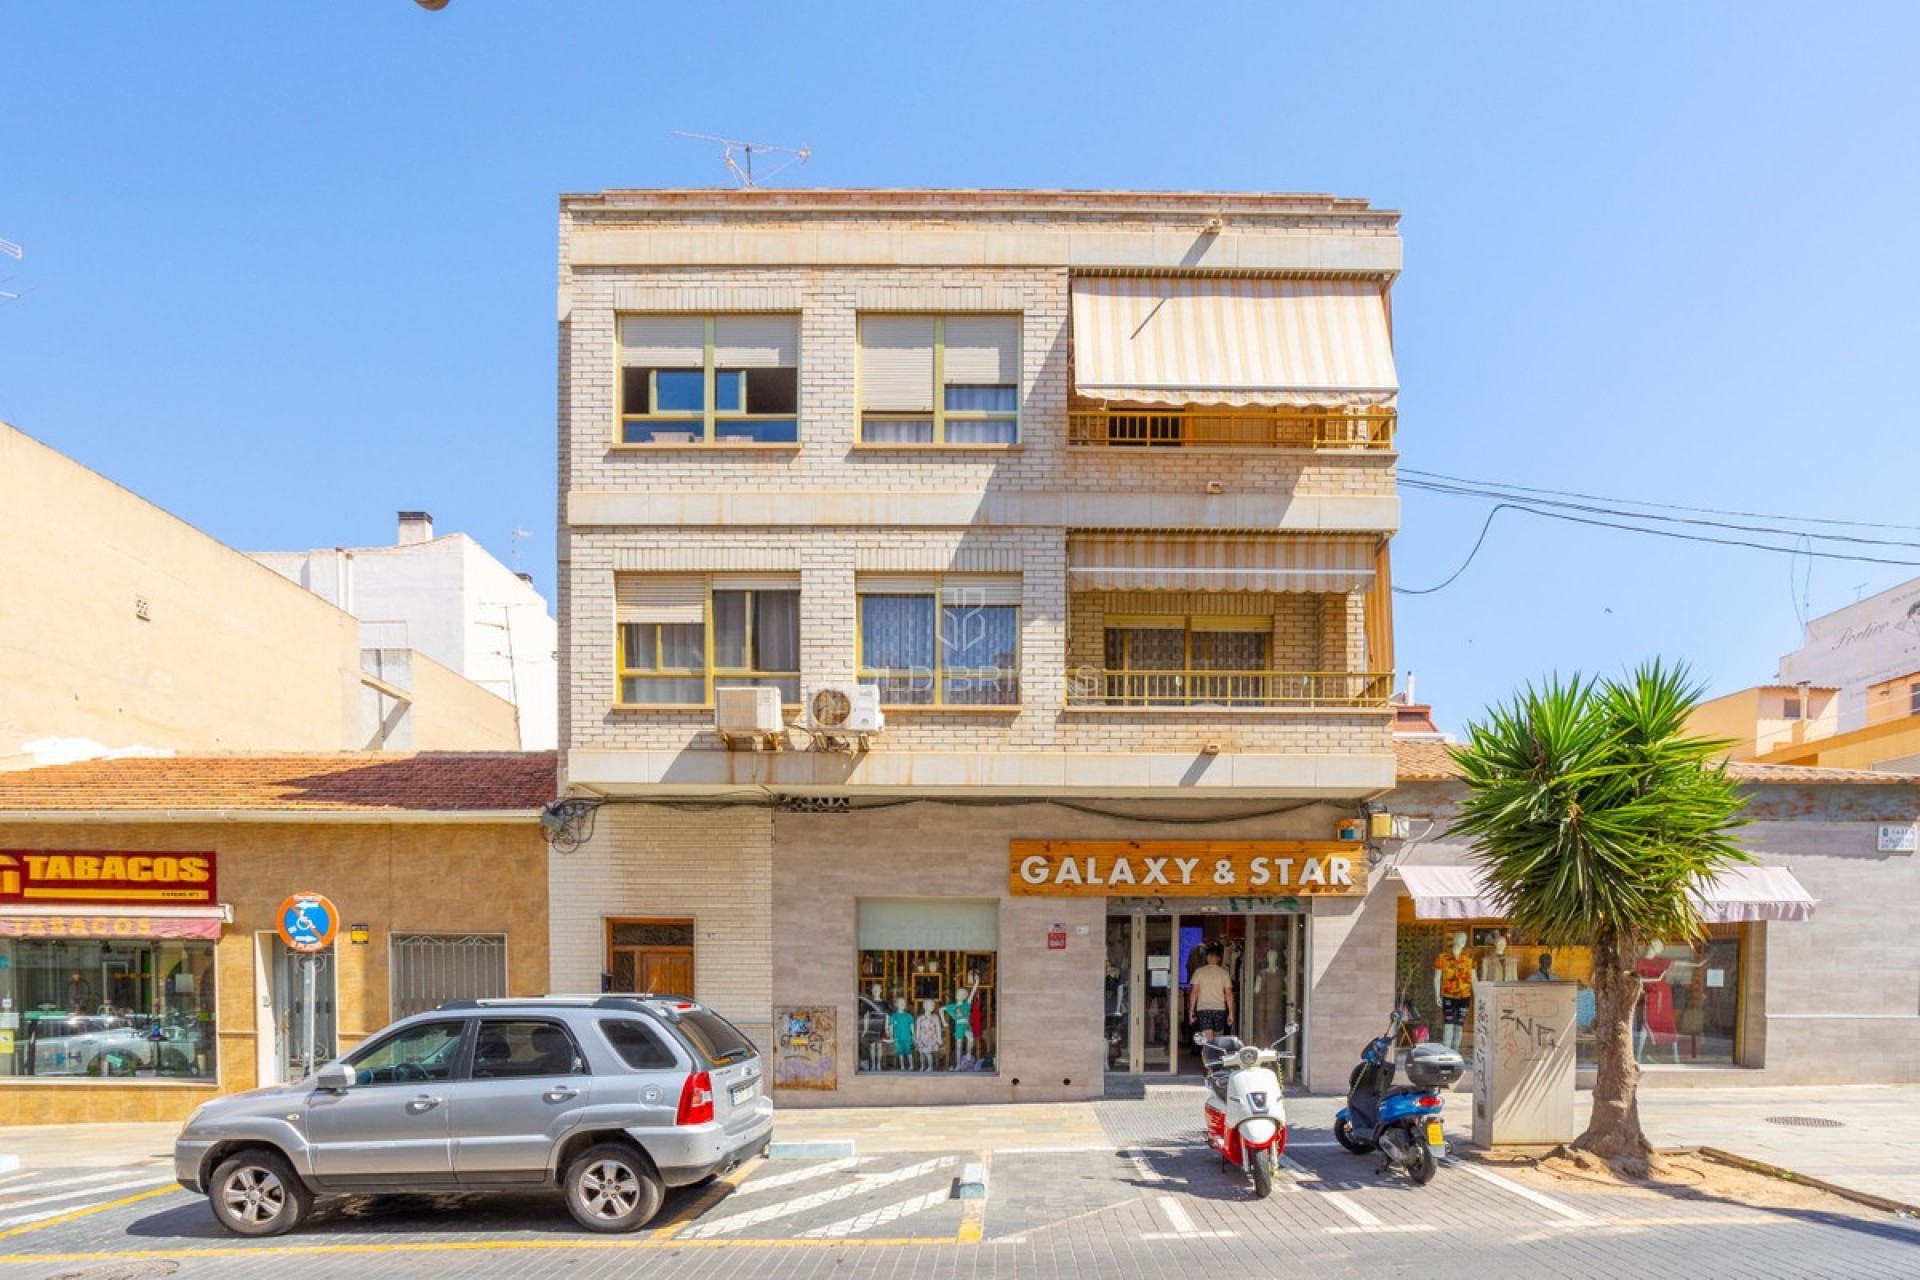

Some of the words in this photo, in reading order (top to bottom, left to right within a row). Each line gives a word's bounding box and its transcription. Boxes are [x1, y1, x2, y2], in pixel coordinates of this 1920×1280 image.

[24, 855, 209, 882] TABACOS
[1020, 855, 1199, 884] GALAXY
[1213, 859, 1236, 884] &
[1250, 857, 1352, 885] STAR
[12, 915, 151, 935] TABACOS
